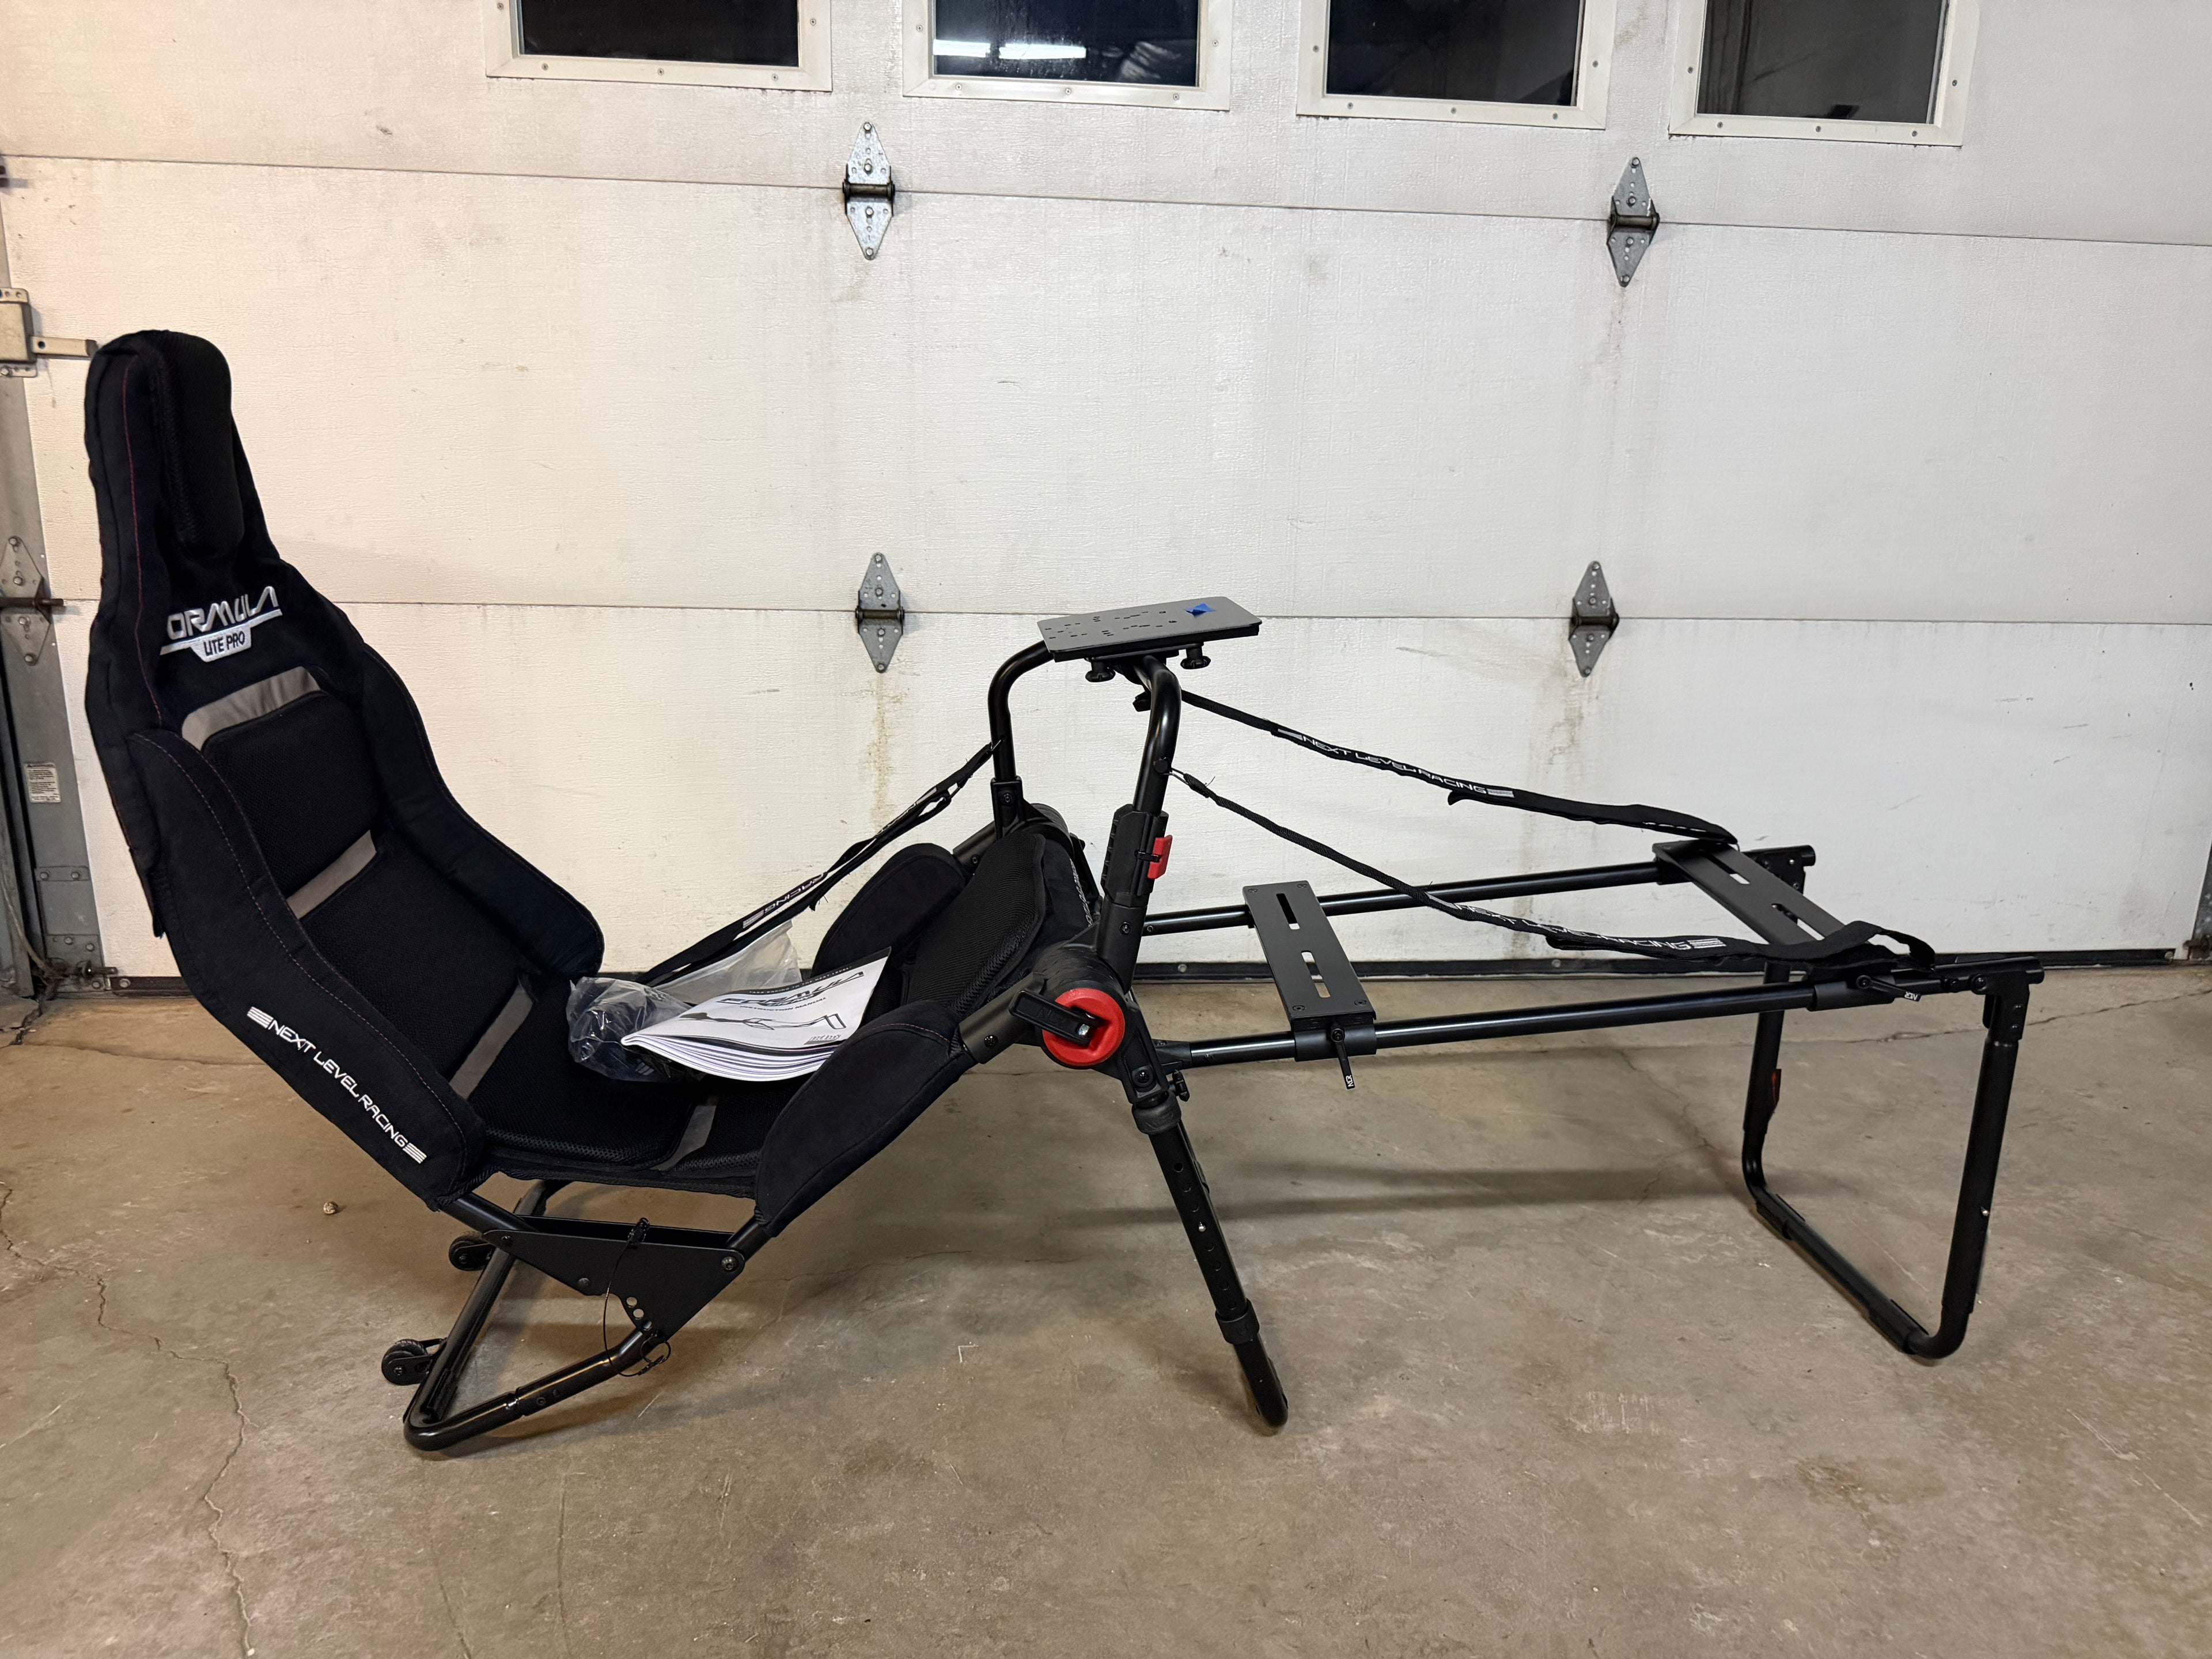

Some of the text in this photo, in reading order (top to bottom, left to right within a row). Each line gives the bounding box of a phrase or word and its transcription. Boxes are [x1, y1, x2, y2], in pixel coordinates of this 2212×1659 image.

[166, 585, 279, 640] ORMULA
[203, 630, 245, 656] LITE PRO
[1302, 736, 1487, 794] NEXT LEVEL RACING
[267, 1020, 408, 1148] NEXT LEVEL RACING
